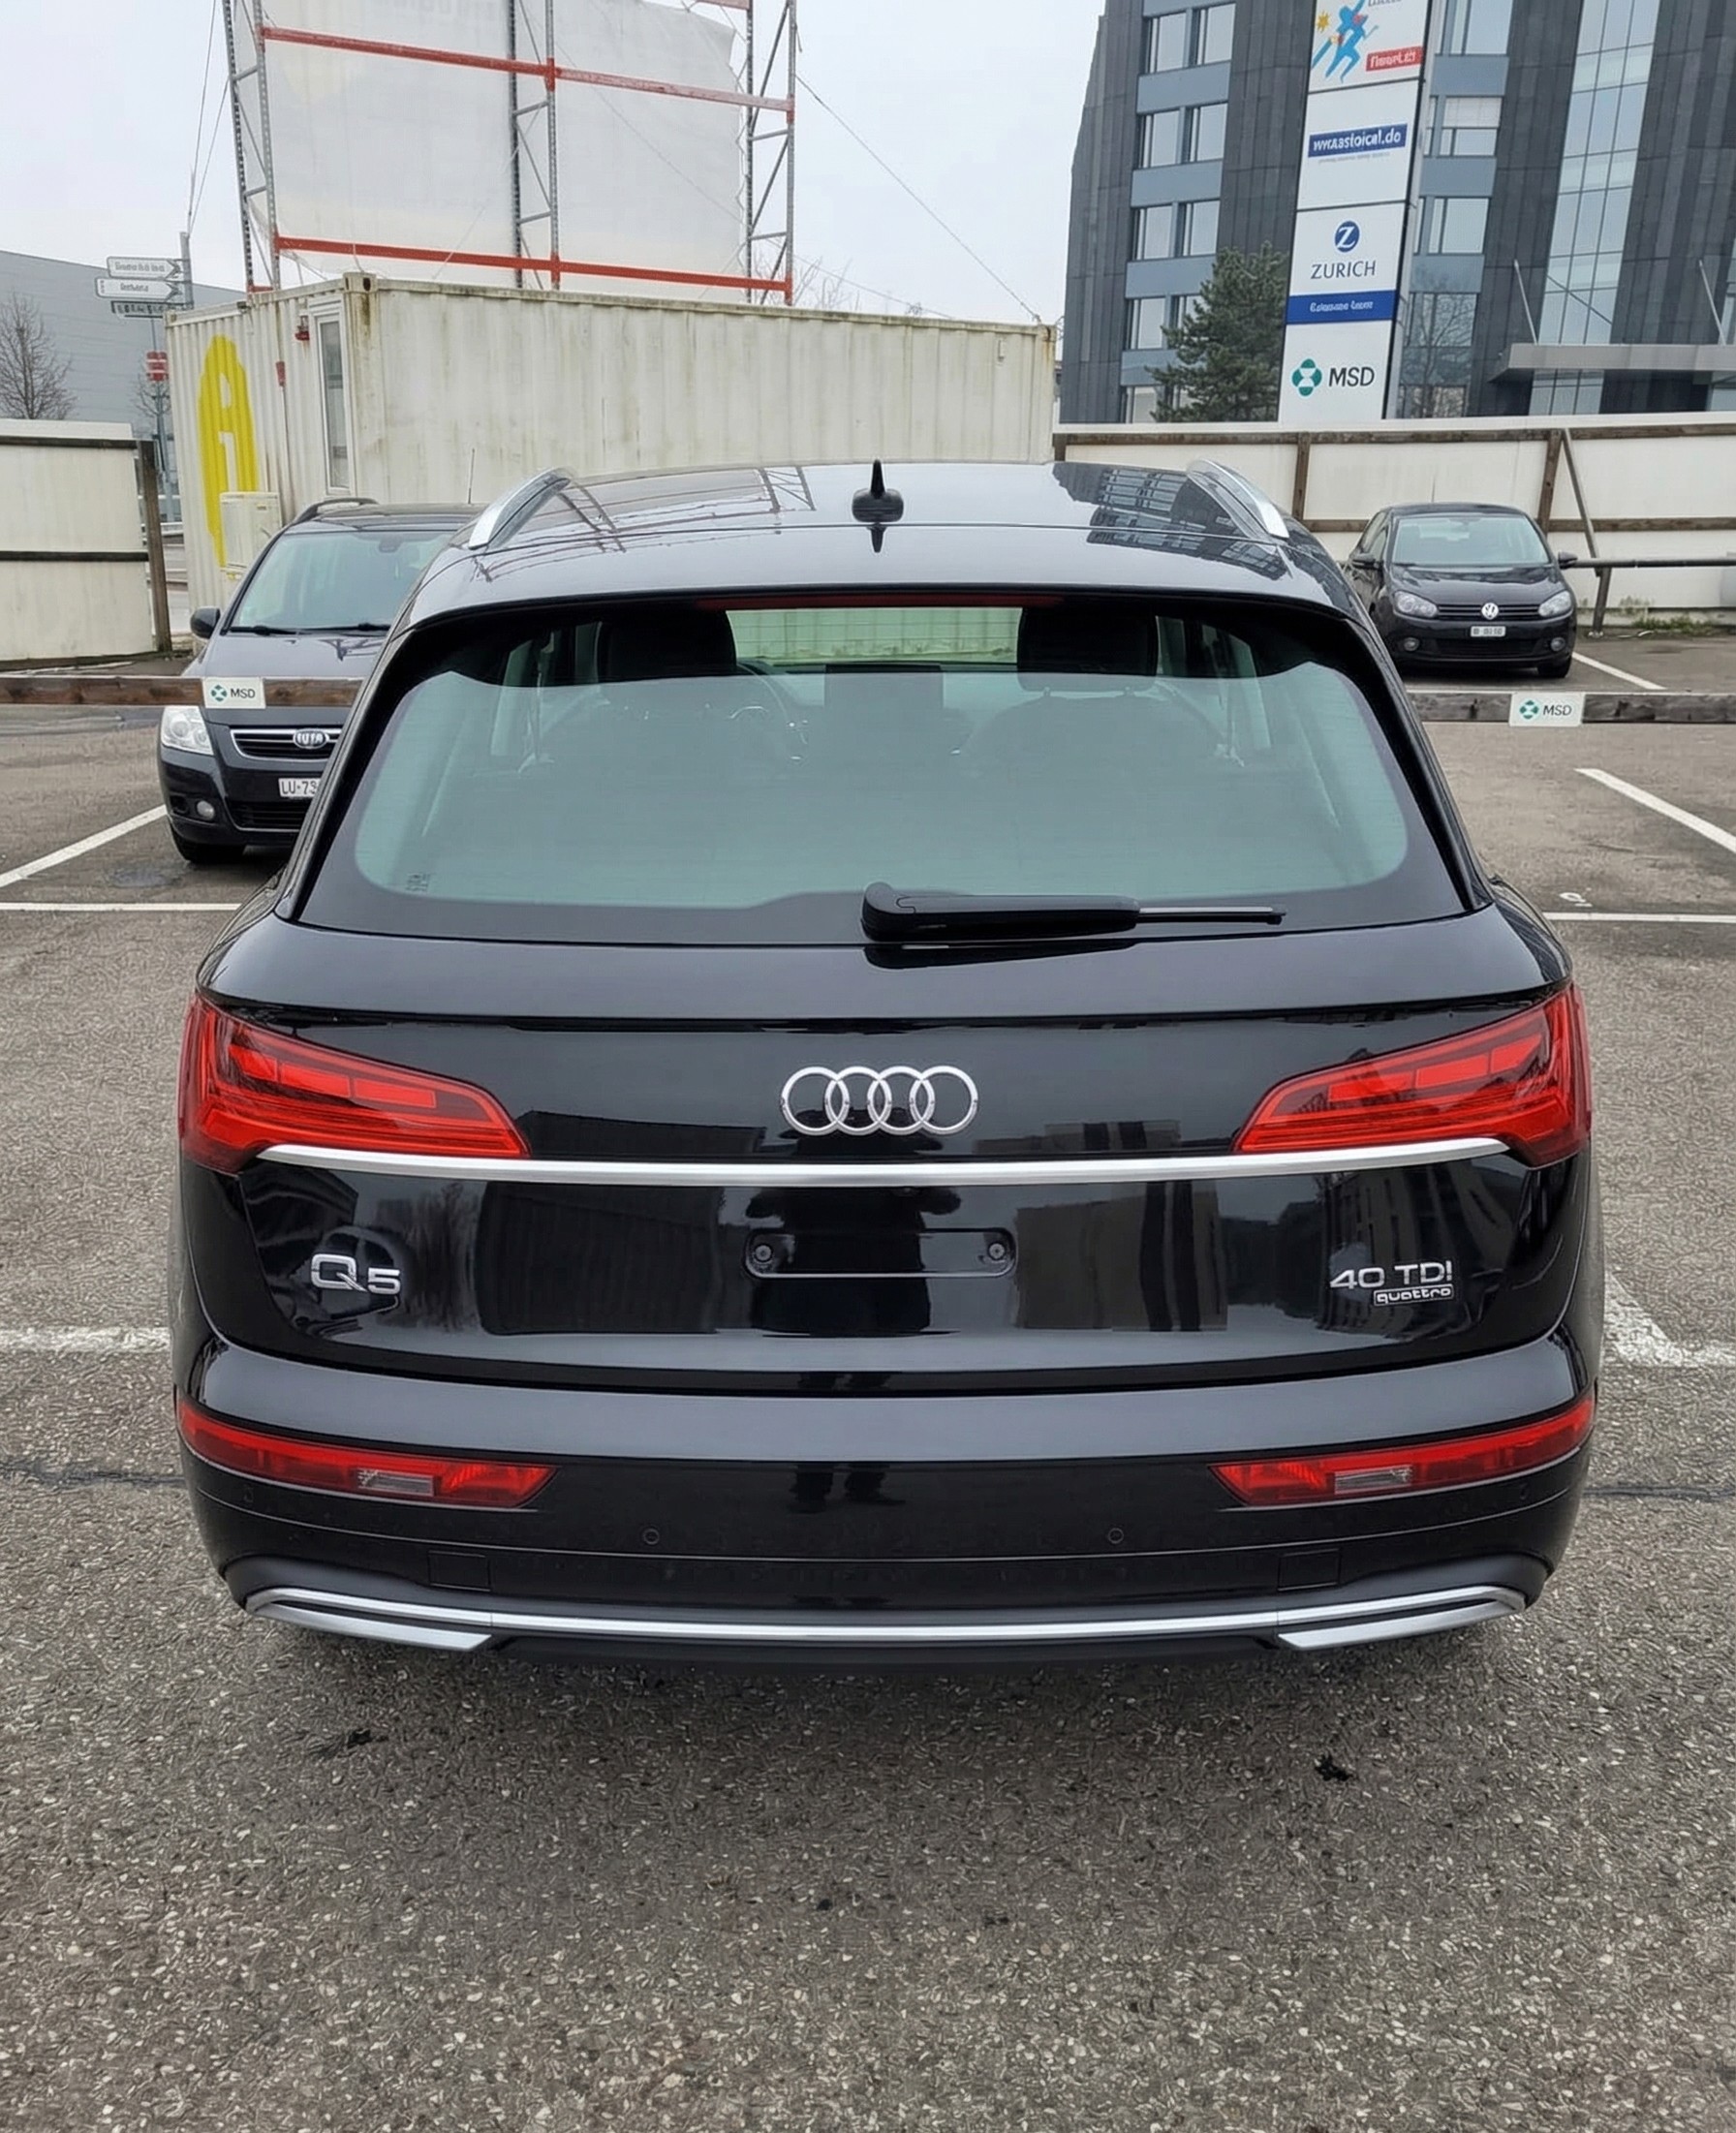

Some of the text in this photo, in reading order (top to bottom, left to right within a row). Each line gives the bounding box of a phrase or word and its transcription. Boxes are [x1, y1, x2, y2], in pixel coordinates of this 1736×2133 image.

[1311, 261, 1377, 279] ZURICH
[1328, 366, 1375, 387] MSD
[230, 688, 256, 699] MSD
[1542, 704, 1572, 716] MSD
[311, 1253, 400, 1295] Q5
[1329, 1267, 1385, 1289] 40
[1376, 1287, 1452, 1305] quattro
